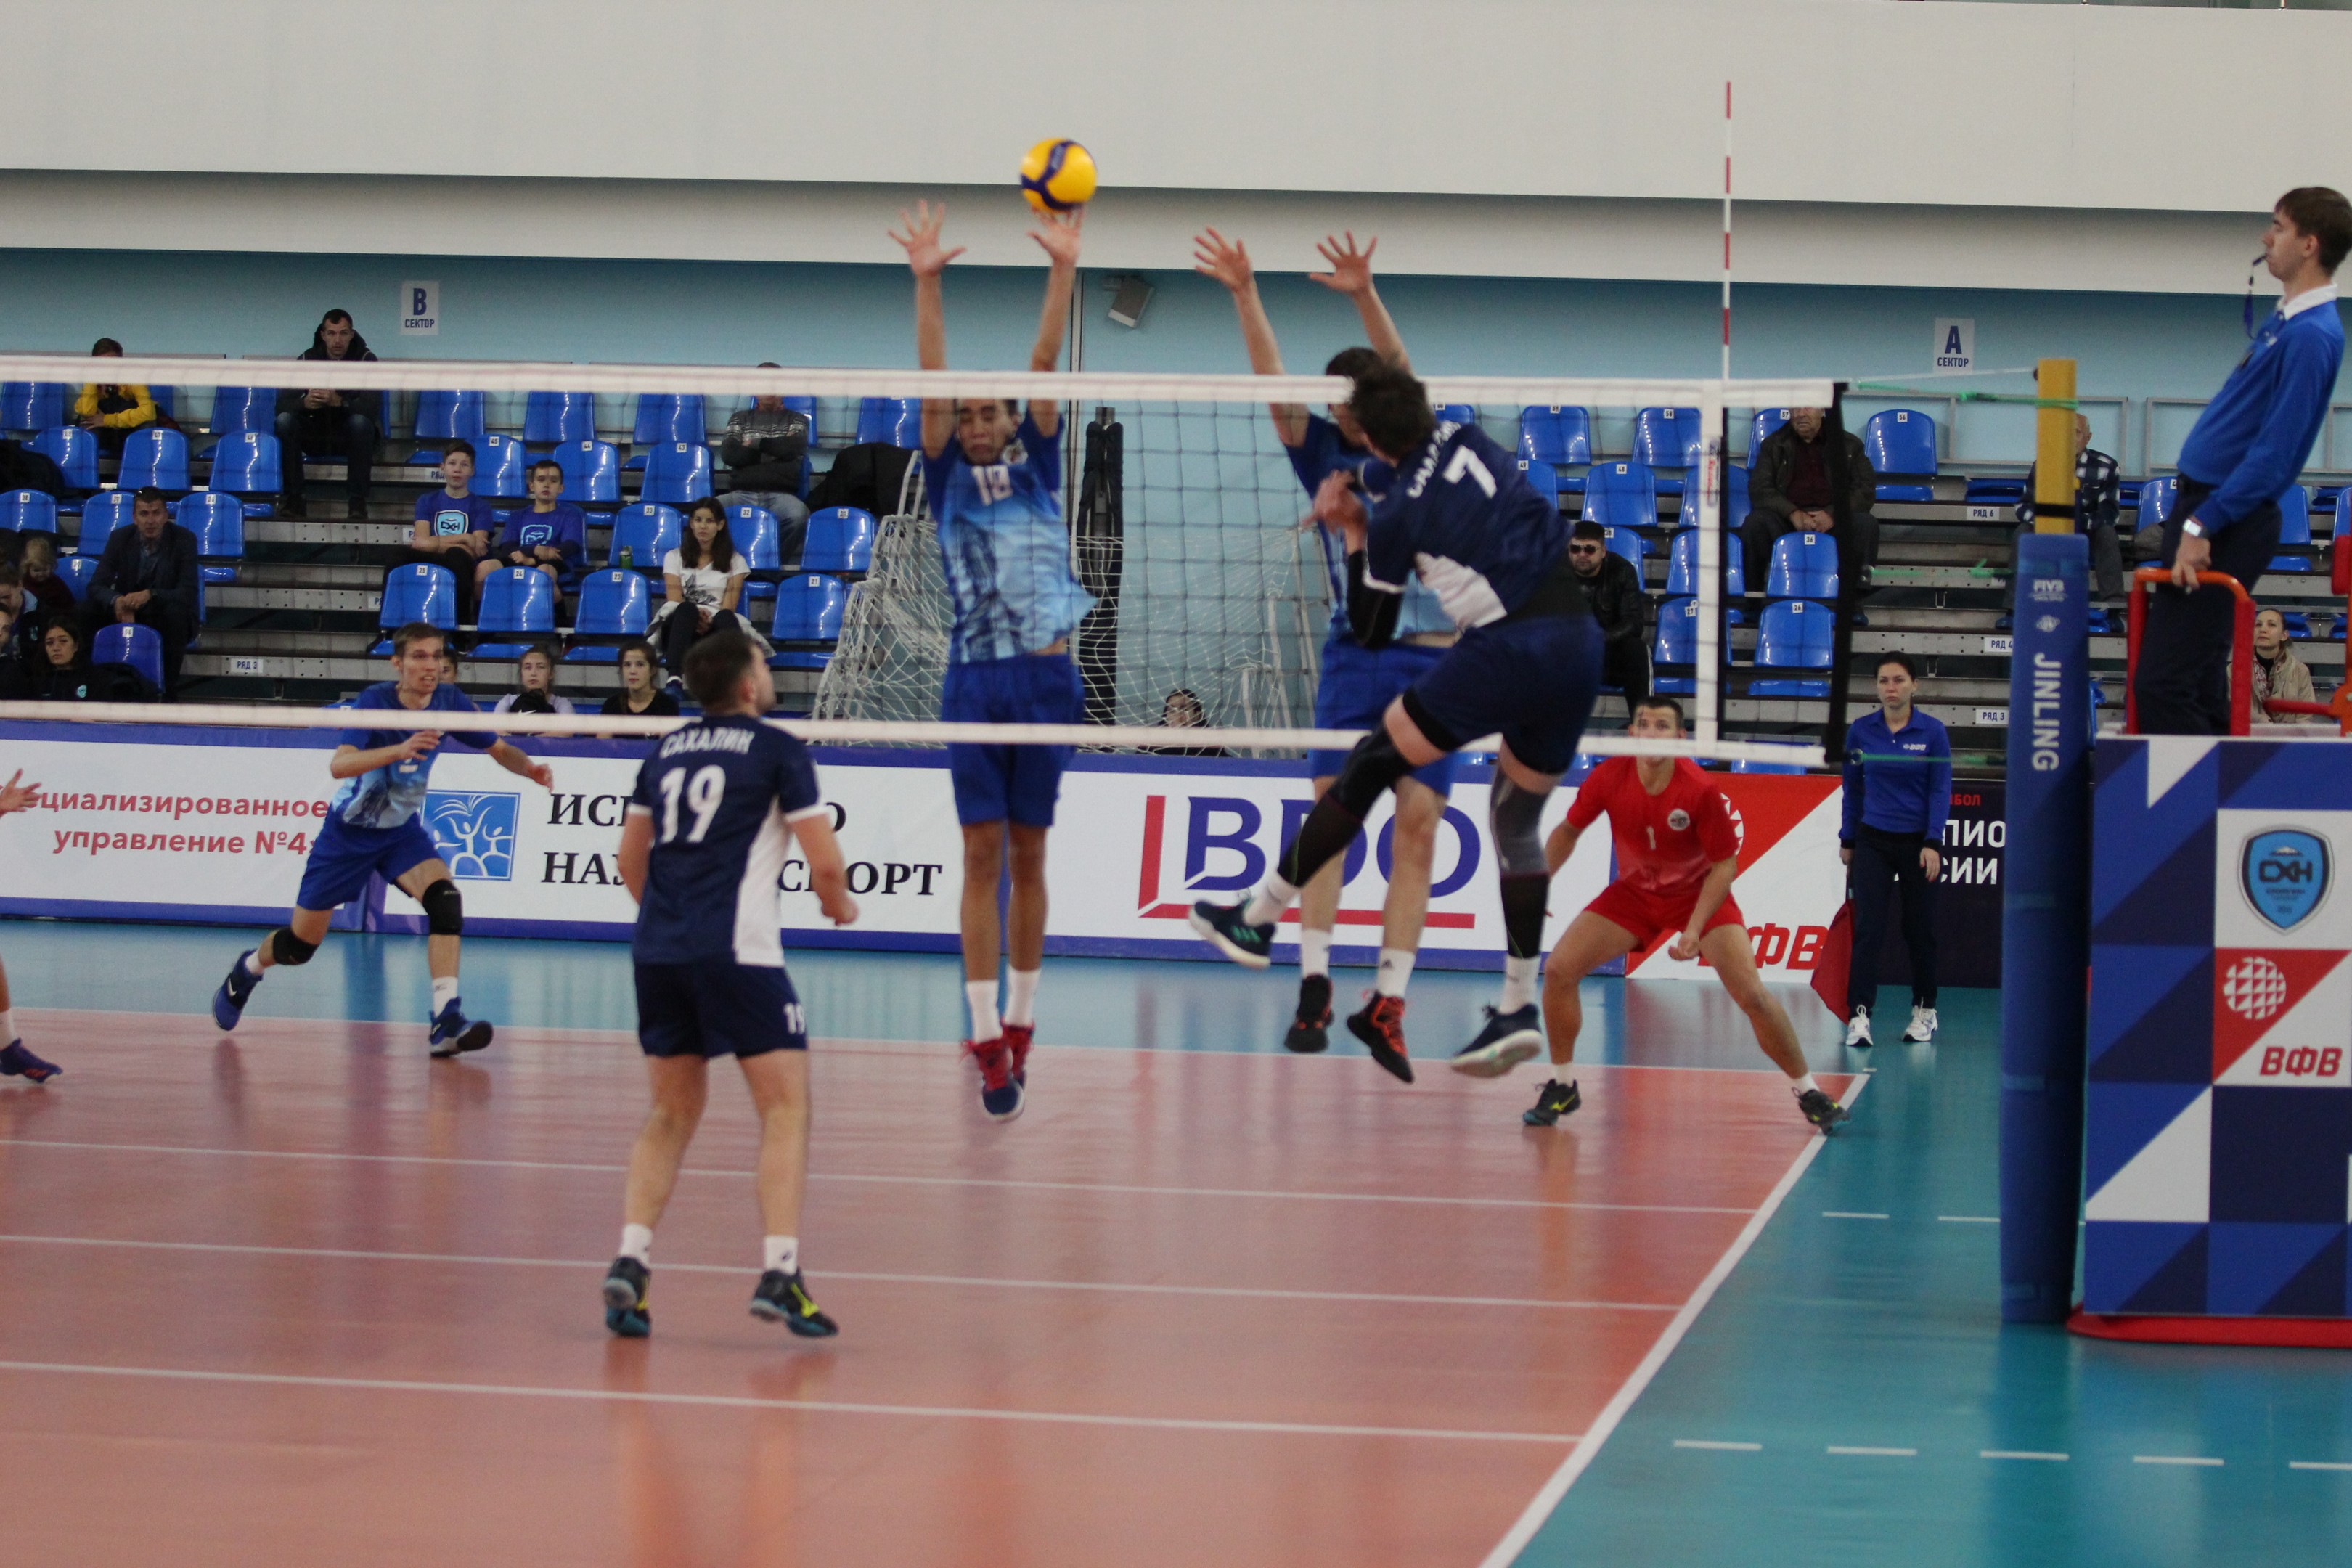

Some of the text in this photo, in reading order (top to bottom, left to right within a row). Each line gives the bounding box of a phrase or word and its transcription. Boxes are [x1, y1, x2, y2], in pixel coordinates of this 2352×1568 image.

[413, 287, 428, 316] В
[405, 319, 435, 328] СЕКТОР
[1945, 325, 1962, 354] А
[1937, 357, 1969, 367] СЕКТОР
[1442, 444, 1498, 499] 7
[1991, 640, 2006, 649] РЯД
[237, 661, 251, 670] РЯД
[1983, 711, 1997, 721] РЯД
[2032, 653, 2062, 771] JINLING
[659, 727, 756, 759] САХАЛИН
[41, 792, 328, 820] циализированное
[660, 765, 726, 844] 19
[53, 830, 245, 855] управление
[1646, 825, 1656, 850] 1
[2260, 1046, 2343, 1077] ВФВ
